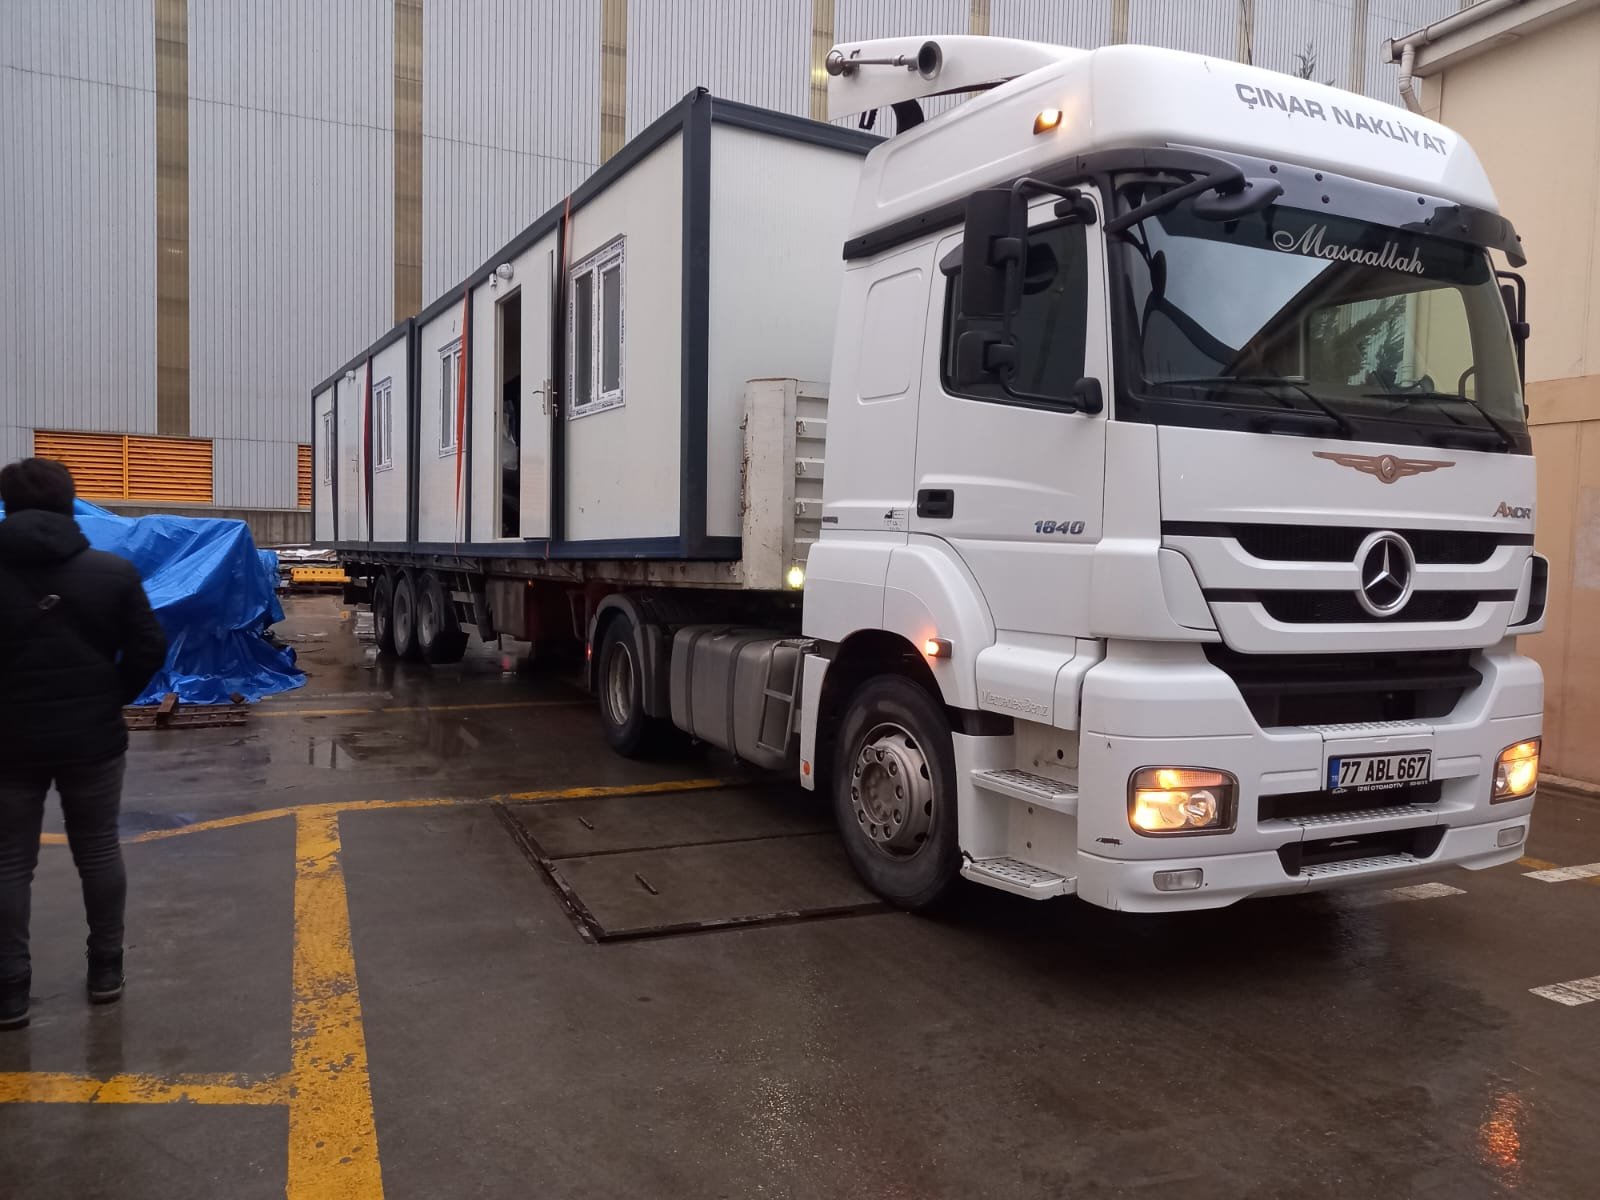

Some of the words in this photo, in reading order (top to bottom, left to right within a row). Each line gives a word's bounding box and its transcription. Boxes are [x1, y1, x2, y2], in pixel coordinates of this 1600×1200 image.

[1235, 83, 1327, 121] ÇINAR
[1331, 105, 1447, 156] NAKLİYAT
[1272, 223, 1425, 275] Masaallah
[1034, 520, 1086, 535] 1840
[1341, 761, 1362, 784] 77
[1365, 758, 1394, 782] ABL
[1397, 757, 1427, 780] 667
